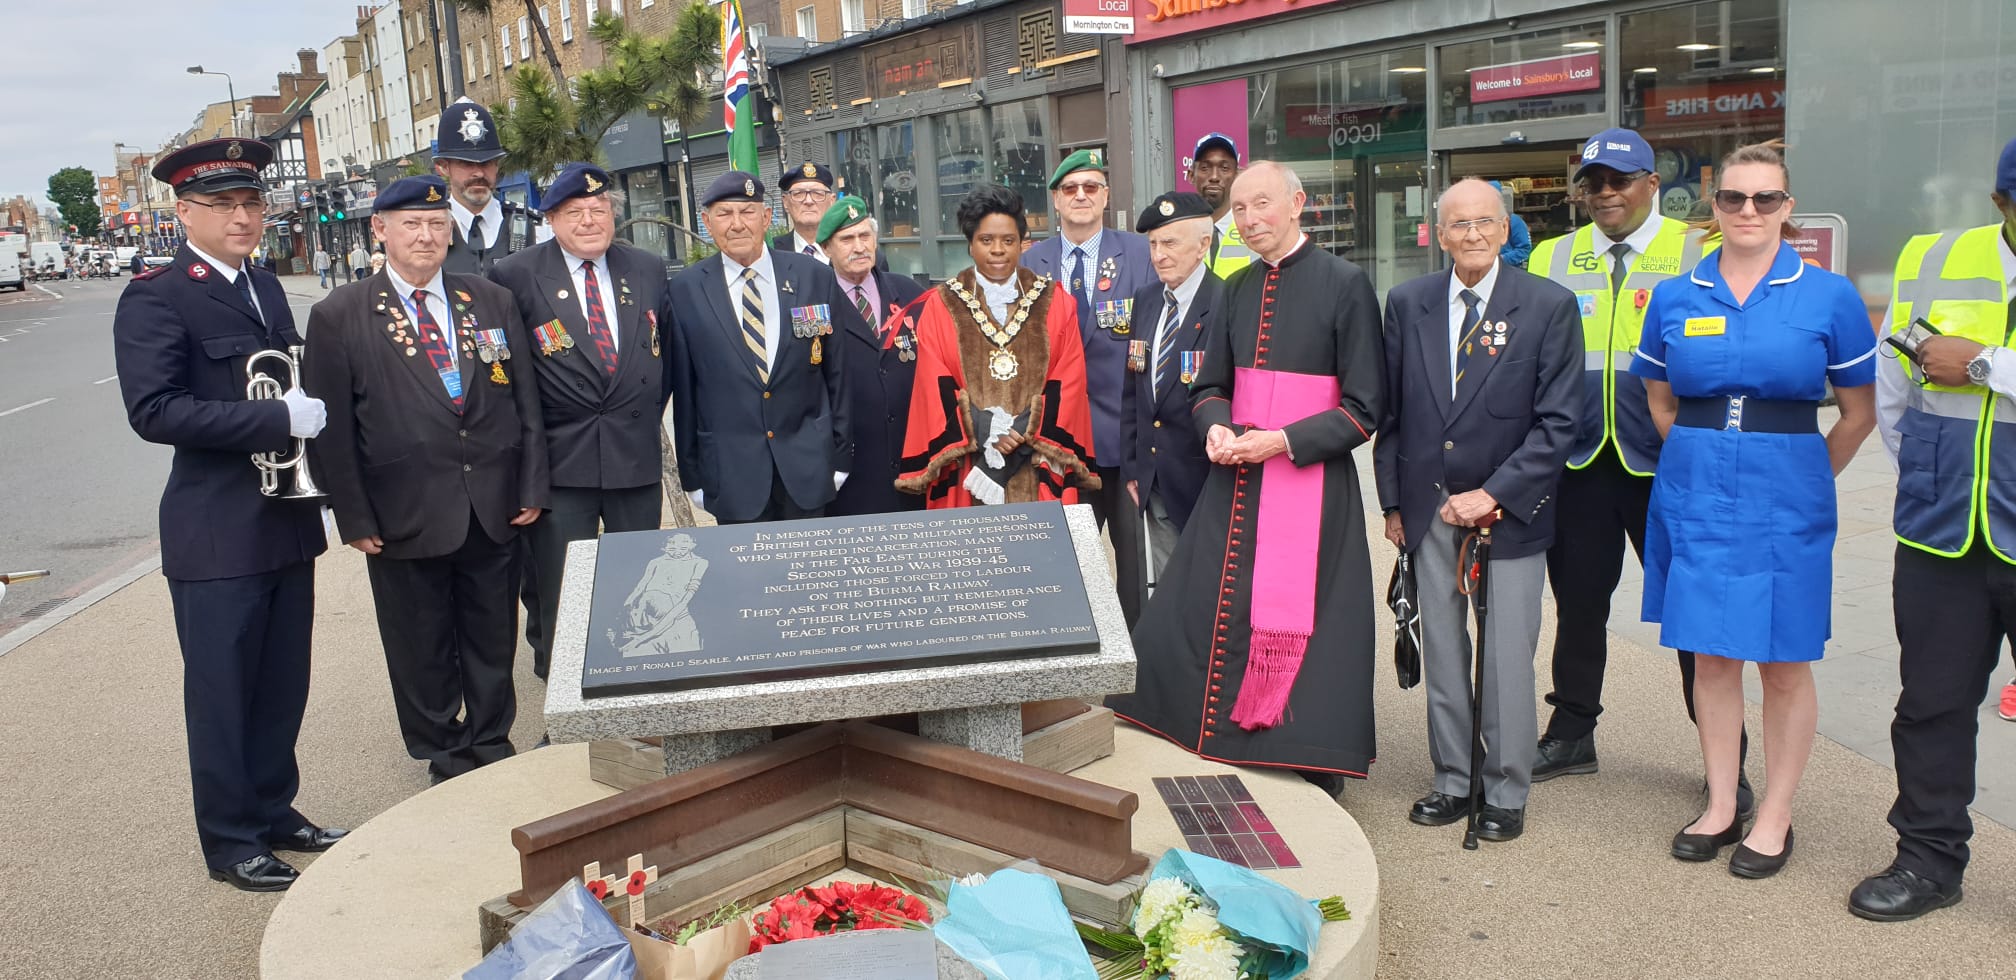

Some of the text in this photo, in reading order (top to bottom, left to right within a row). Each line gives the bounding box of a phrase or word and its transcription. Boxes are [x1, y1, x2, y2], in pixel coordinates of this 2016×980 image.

[1098, 0, 1129, 11] Local
[1073, 20, 1129, 30] Mornington Cres
[1475, 67, 1593, 91] Welcome to Sainsbury's Local
[1308, 114, 1332, 125] Meat
[1342, 113, 1359, 125] fish
[192, 165, 209, 175] THE
[1182, 157, 1193, 170] Op
[1667, 203, 1688, 212] NOW
[1641, 255, 1680, 265] EDWARDS
[1641, 263, 1679, 272] SECURITY
[193, 265, 207, 277] S
[729, 522, 1055, 553] OF BRITISH CIVILIAN AND MILITARY PERSONNEL
[756, 513, 1028, 541] IN MEMORY OF THE TENS OF THOUSANDS
[737, 554, 771, 563] WHO
[776, 548, 847, 560] SUFFERED
[965, 535, 1004, 546] MANY
[810, 559, 838, 568] THE
[844, 556, 871, 566] FAR
[876, 553, 914, 563] EAST
[918, 549, 971, 559] DURING
[975, 547, 1003, 555] THE
[787, 555, 1008, 581] SECOND WORLD WAR 1939-45
[764, 565, 1032, 594] INCLUDING THOSE FORCED TO LABOUR
[739, 585, 1062, 619] THEY ASK FOR NOTHING BUT REMEMBRANCE
[809, 593, 828, 601] ON
[833, 590, 862, 599] THE
[868, 586, 923, 597] BURMA
[776, 599, 1030, 627] OF THEIR LIVES AND A PROMISE OF
[781, 611, 1029, 639] PEACE FOR FUTURE GENERATIONS.
[589, 666, 622, 675] IMAGE
[625, 664, 639, 672] BY
[642, 660, 684, 670] RONALD
[736, 653, 771, 662] ARTIST
[799, 646, 847, 656] PRISONER
[890, 640, 913, 648] WHO
[916, 636, 968, 646] LABOURED
[1010, 629, 1047, 638] BURMA
[1050, 625, 1092, 634] RAILWAY
